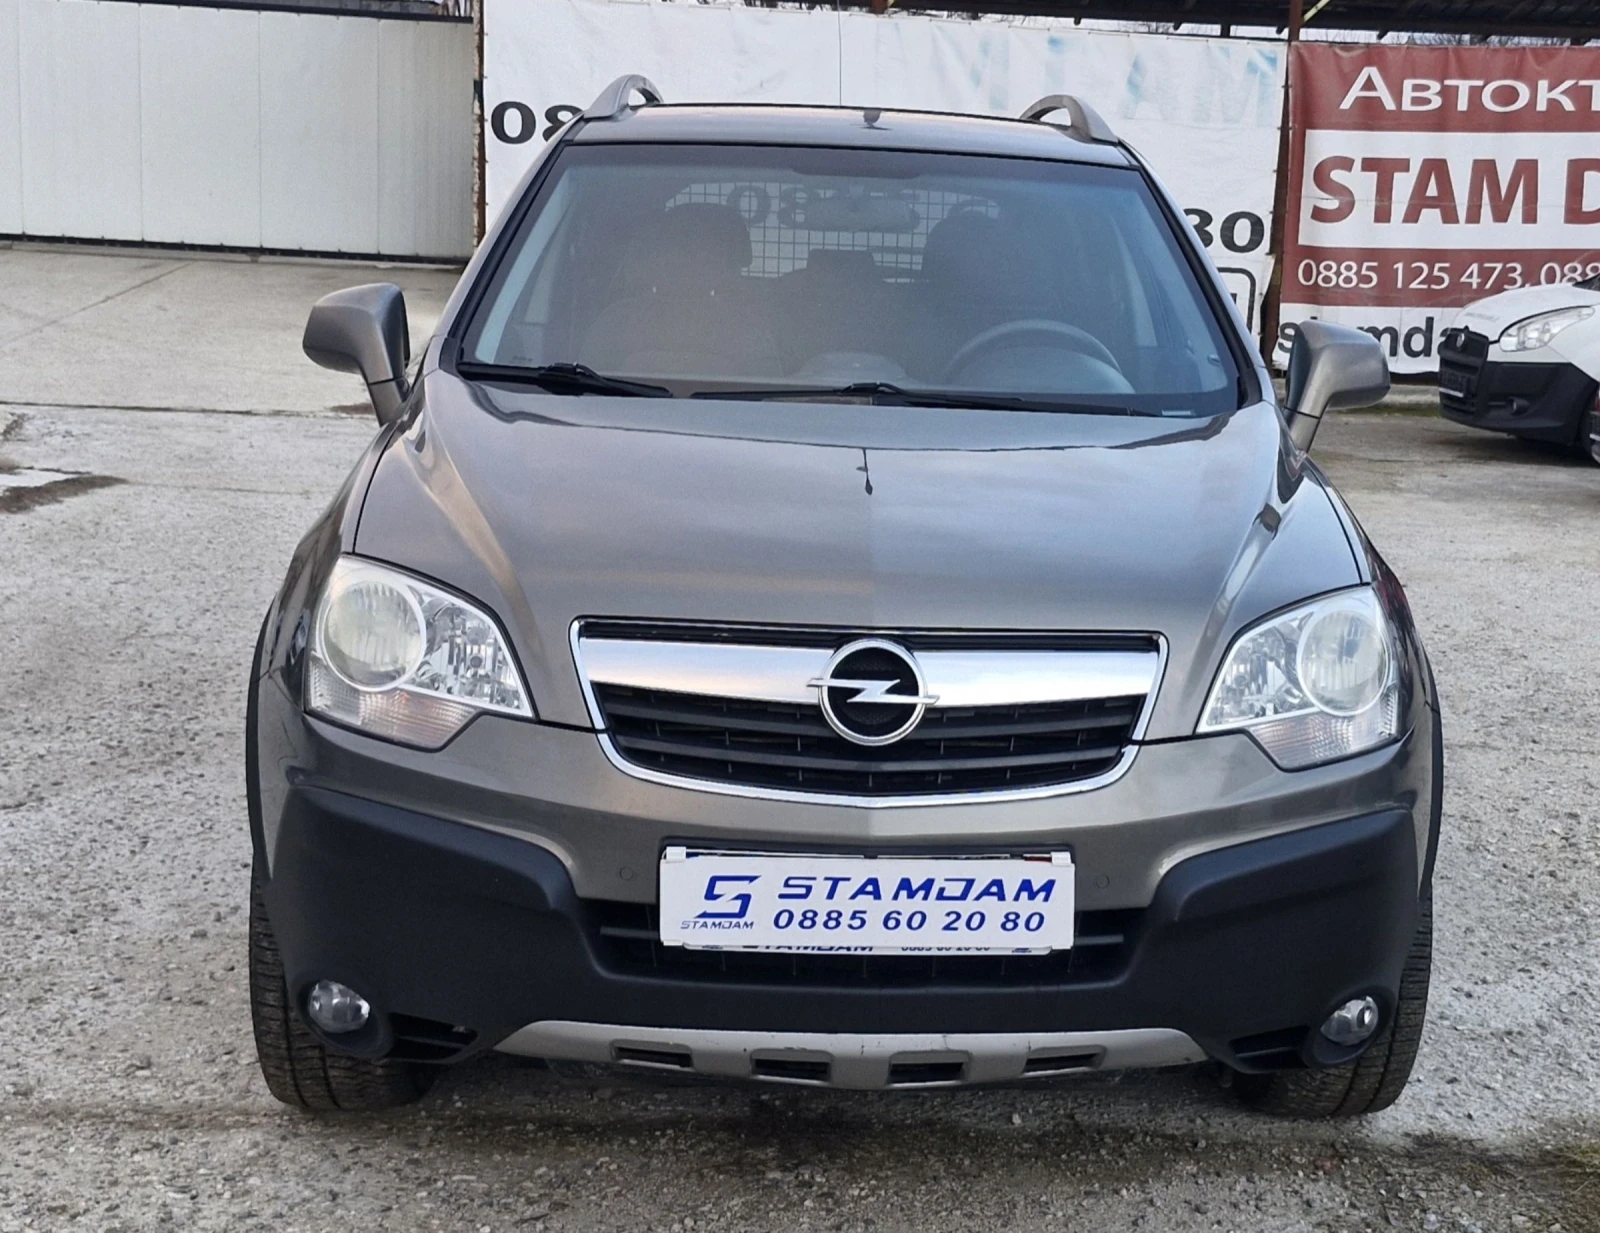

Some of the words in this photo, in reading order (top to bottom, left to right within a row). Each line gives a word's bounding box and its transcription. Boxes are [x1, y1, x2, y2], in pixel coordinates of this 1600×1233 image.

[1310, 155, 1539, 225] STAM
[1298, 259, 1378, 288] 0885
[1393, 261, 1450, 290] 125
[773, 908, 868, 930] 0885
[882, 910, 928, 931] 60
[941, 910, 986, 932] 20
[1000, 911, 1045, 932] 80
